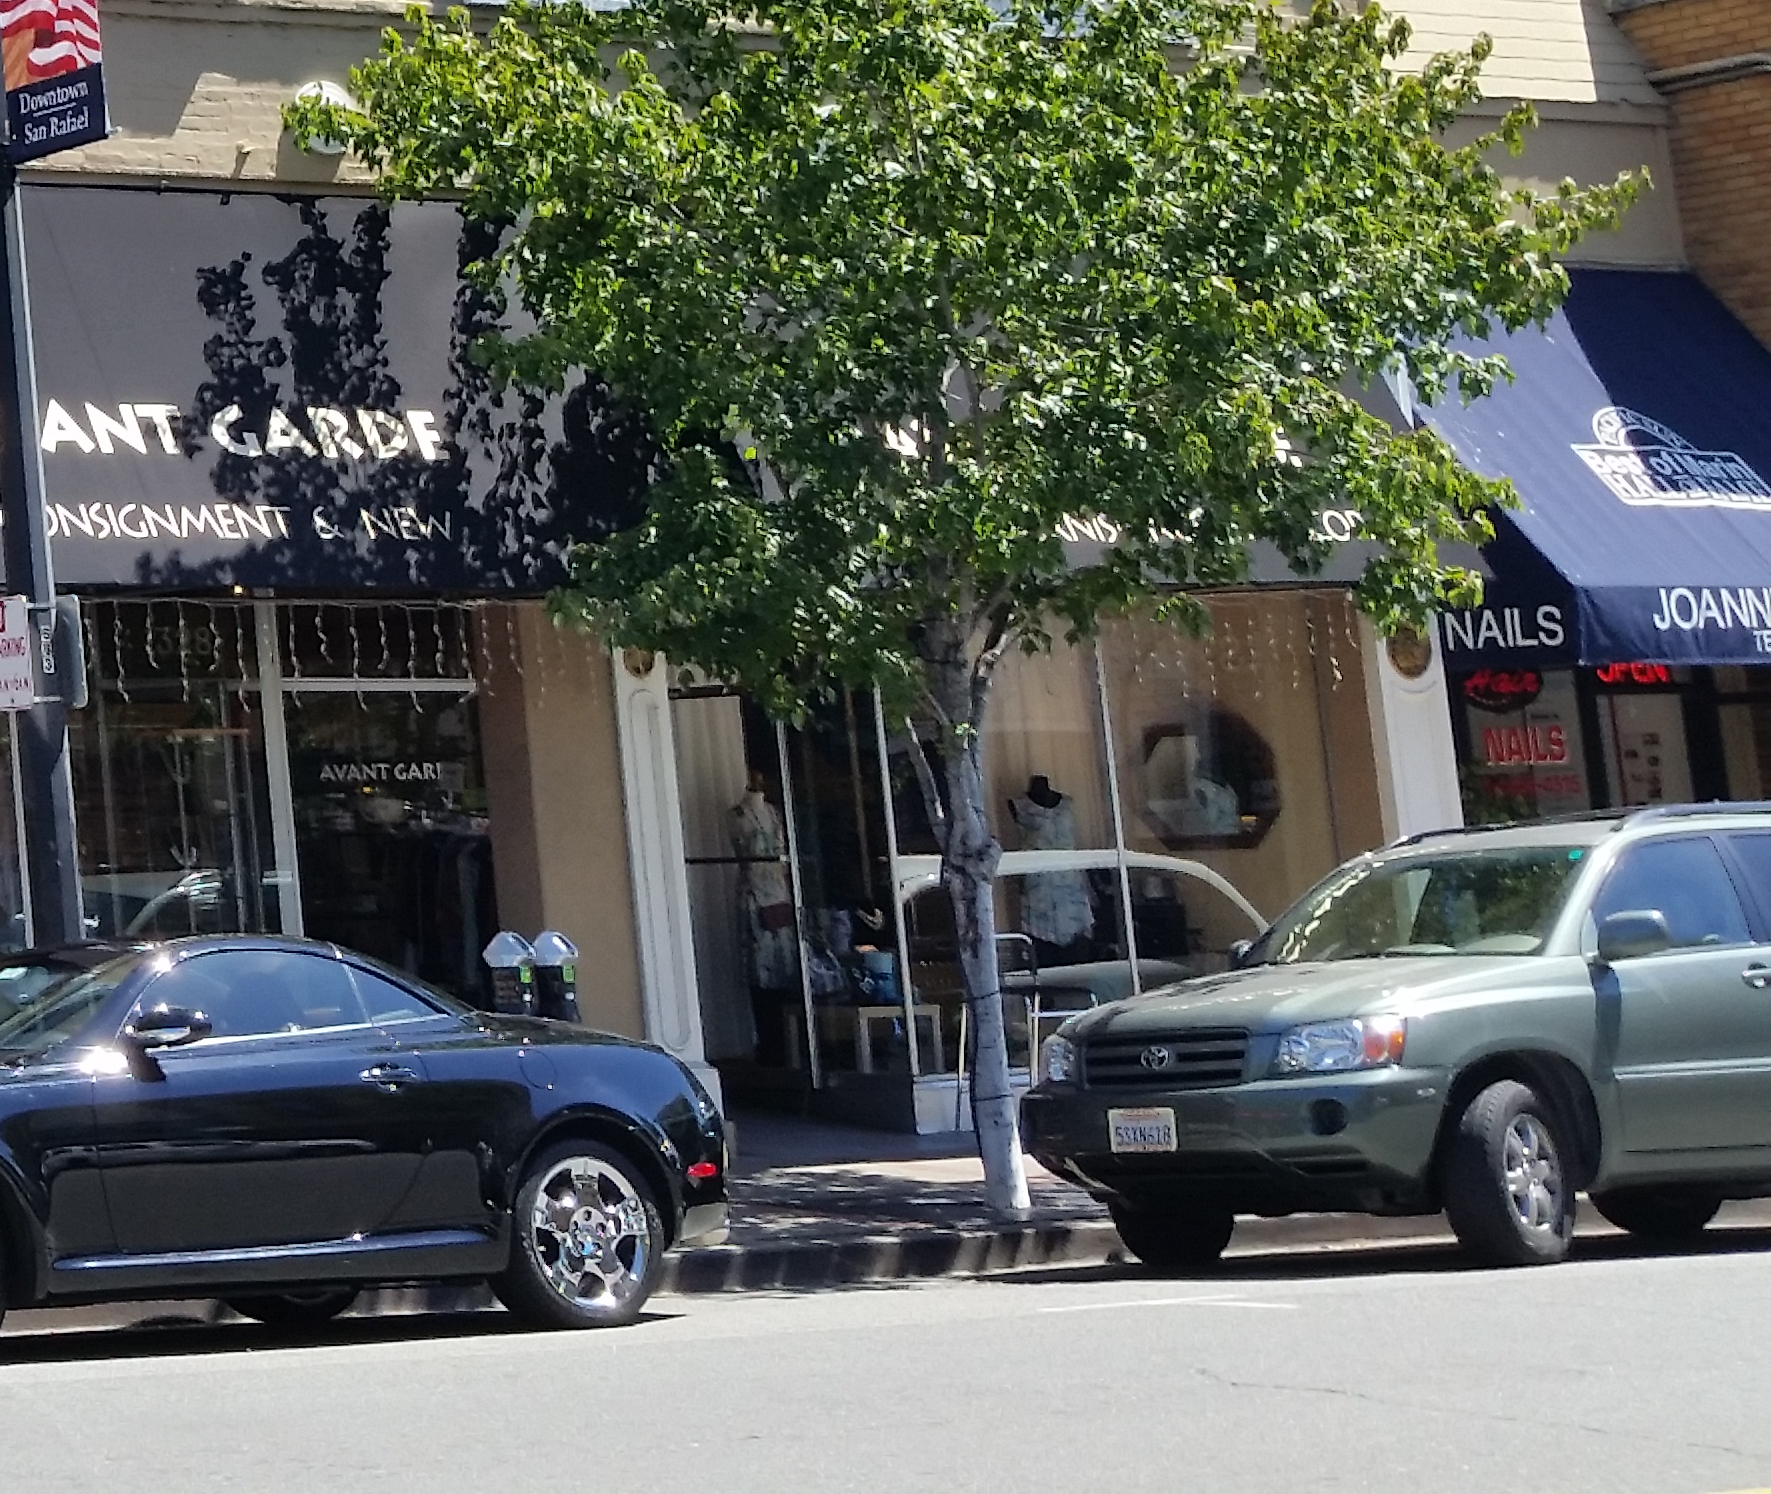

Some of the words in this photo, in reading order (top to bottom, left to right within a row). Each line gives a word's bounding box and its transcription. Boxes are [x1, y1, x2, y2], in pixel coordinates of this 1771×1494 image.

[19, 81, 89, 114] Downtown
[24, 122, 47, 145] San
[50, 106, 89, 136] Rafael
[209, 402, 450, 461] GARDE
[314, 506, 346, 541] &
[360, 506, 453, 542] NEW
[1444, 604, 1566, 652] NAILS
[1482, 724, 1568, 766] NAILS
[320, 763, 390, 781] AVANT
